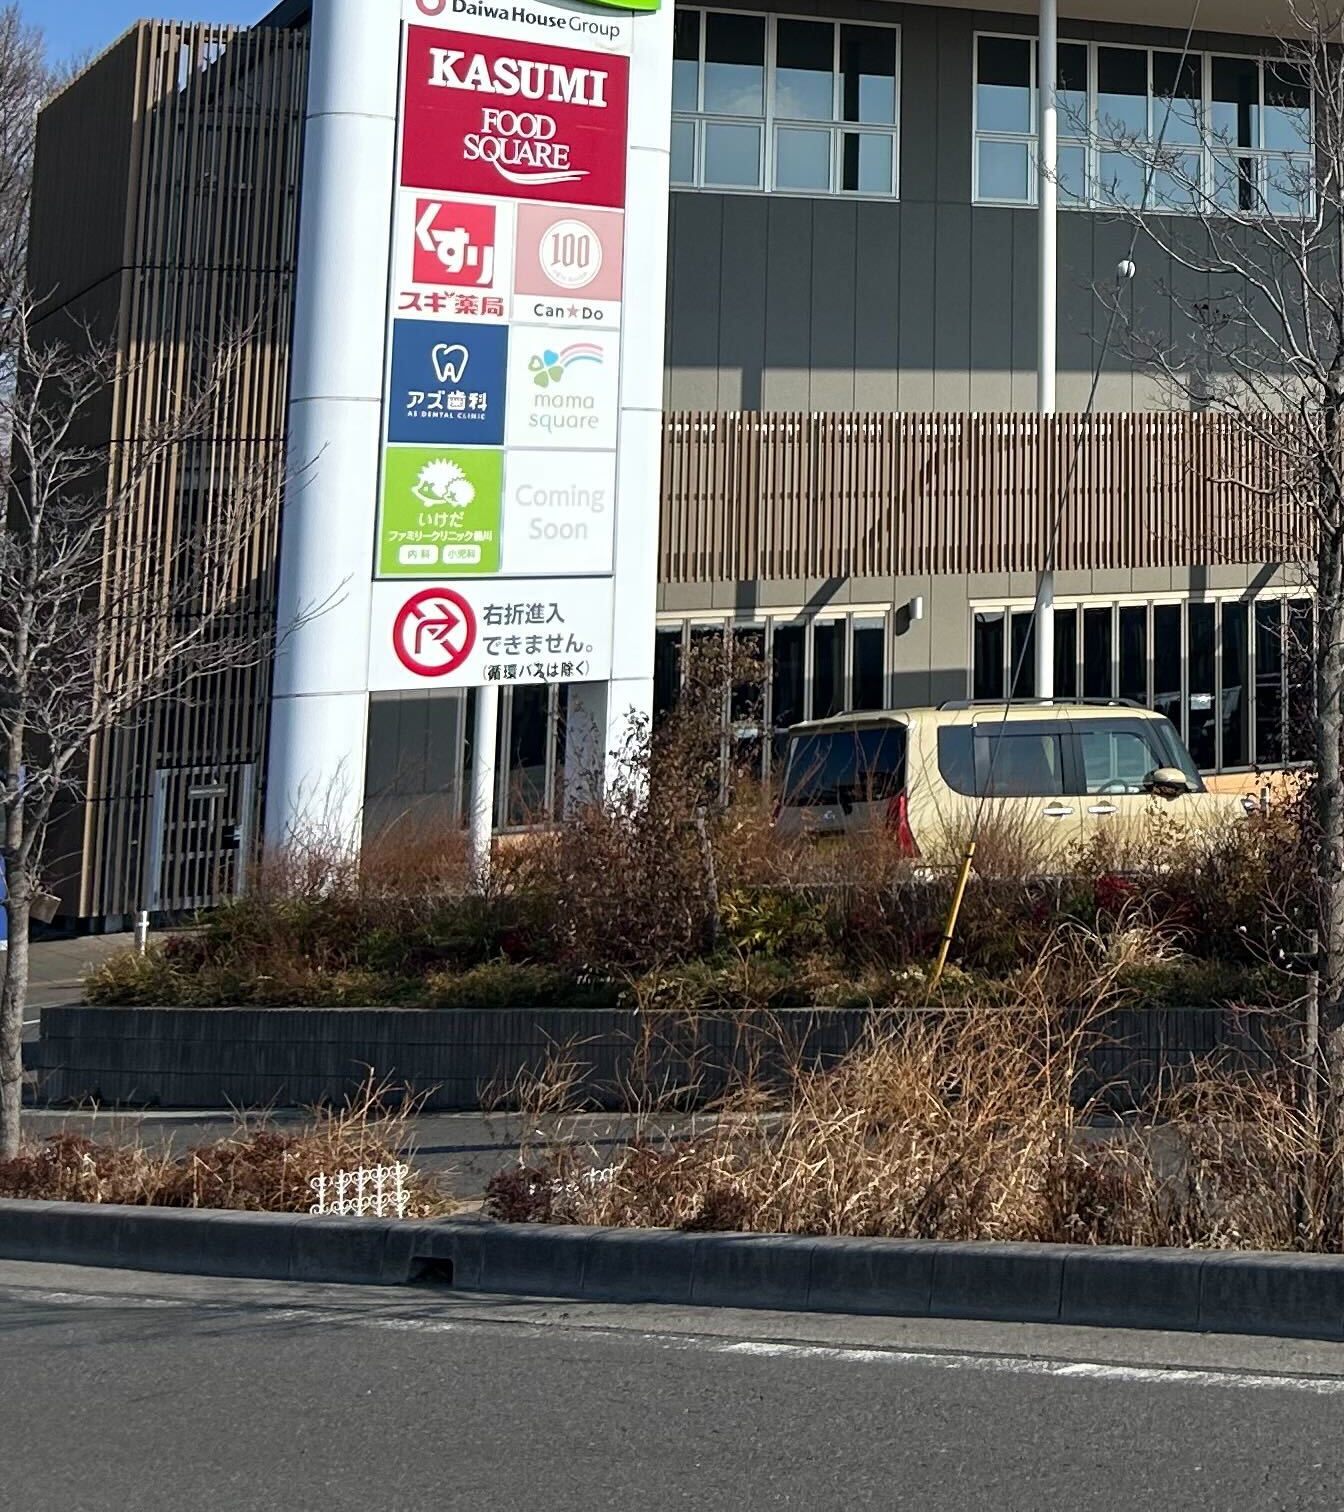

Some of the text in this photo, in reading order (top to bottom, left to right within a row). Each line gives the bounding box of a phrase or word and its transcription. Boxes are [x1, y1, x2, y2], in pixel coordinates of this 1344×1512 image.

[511, 6, 567, 29] House
[568, 16, 621, 40] Group
[428, 47, 609, 107] KASUMI
[481, 107, 557, 139] FOOD
[463, 133, 577, 178] SQUARE
[415, 202, 494, 285] くすり
[550, 233, 590, 268] 100
[398, 291, 504, 317] スギ薬局
[406, 390, 488, 411] アズ歯科
[534, 393, 594, 409] mama
[528, 413, 599, 435] square
[515, 484, 605, 513] Coming
[418, 511, 465, 528] いけだ
[529, 517, 588, 540] Soon
[483, 602, 565, 626] 右折進入
[482, 632, 593, 656] できません。
